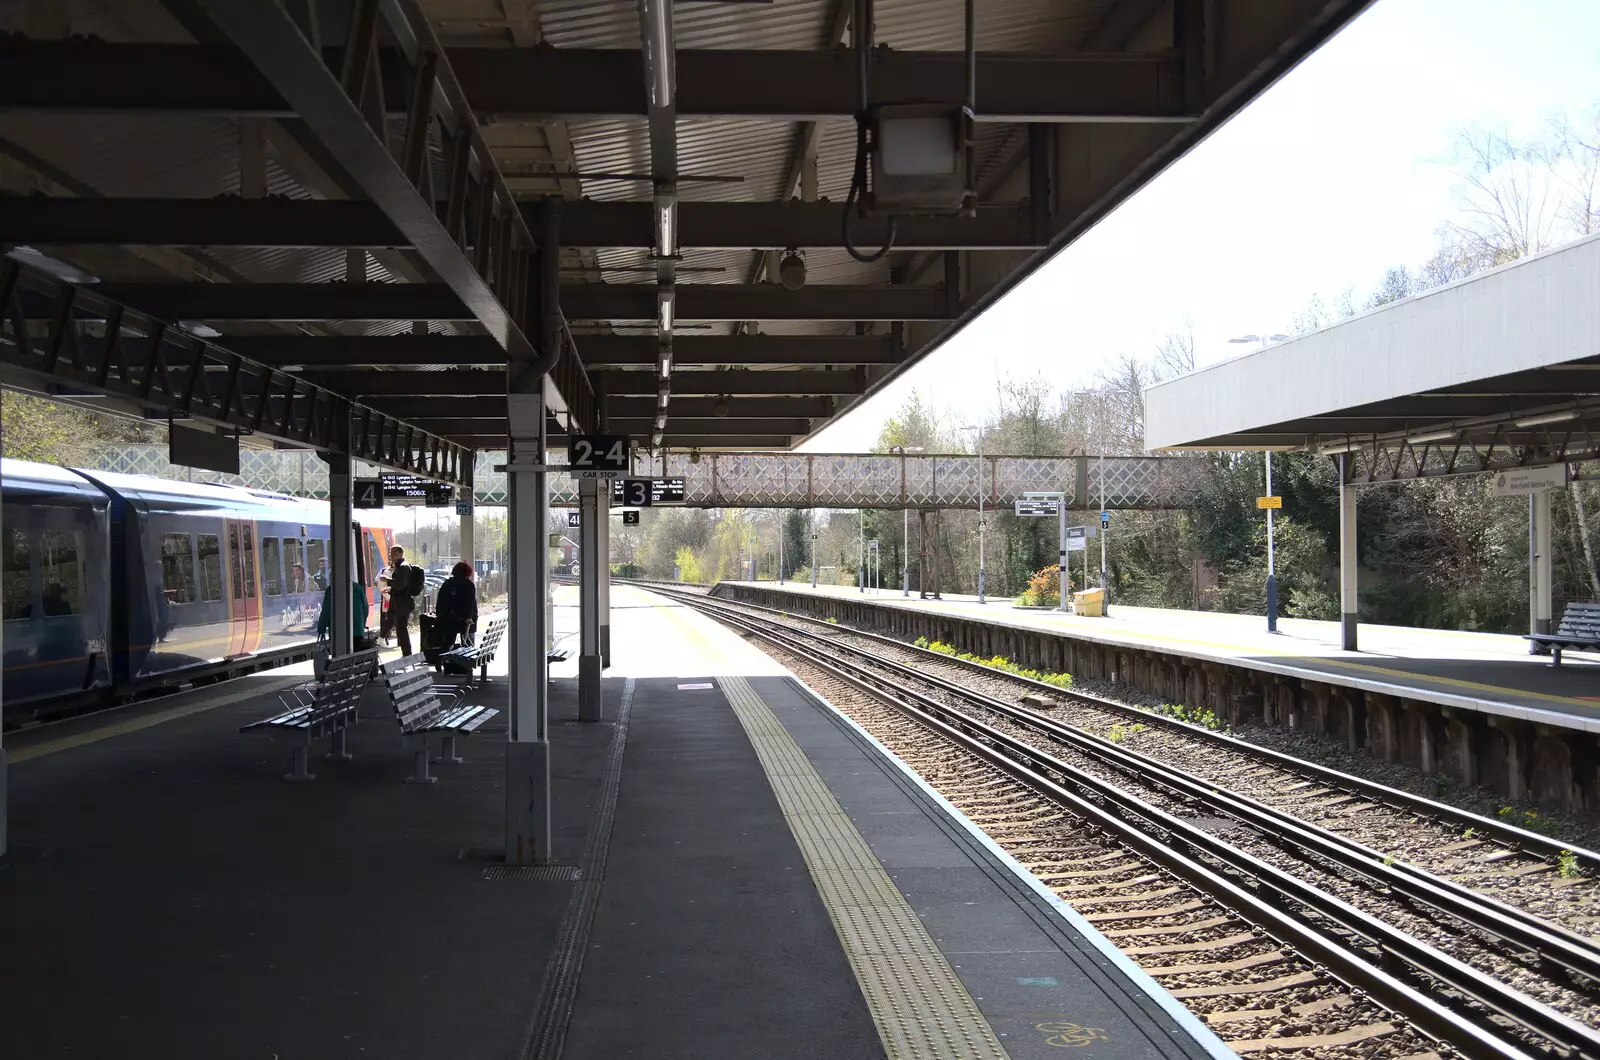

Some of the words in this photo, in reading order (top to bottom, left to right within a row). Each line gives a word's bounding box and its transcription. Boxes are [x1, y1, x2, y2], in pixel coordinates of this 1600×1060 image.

[574, 440, 626, 466] 2-4
[360, 484, 377, 506] 4
[630, 482, 646, 505] 3
[628, 513, 635, 522] 5
